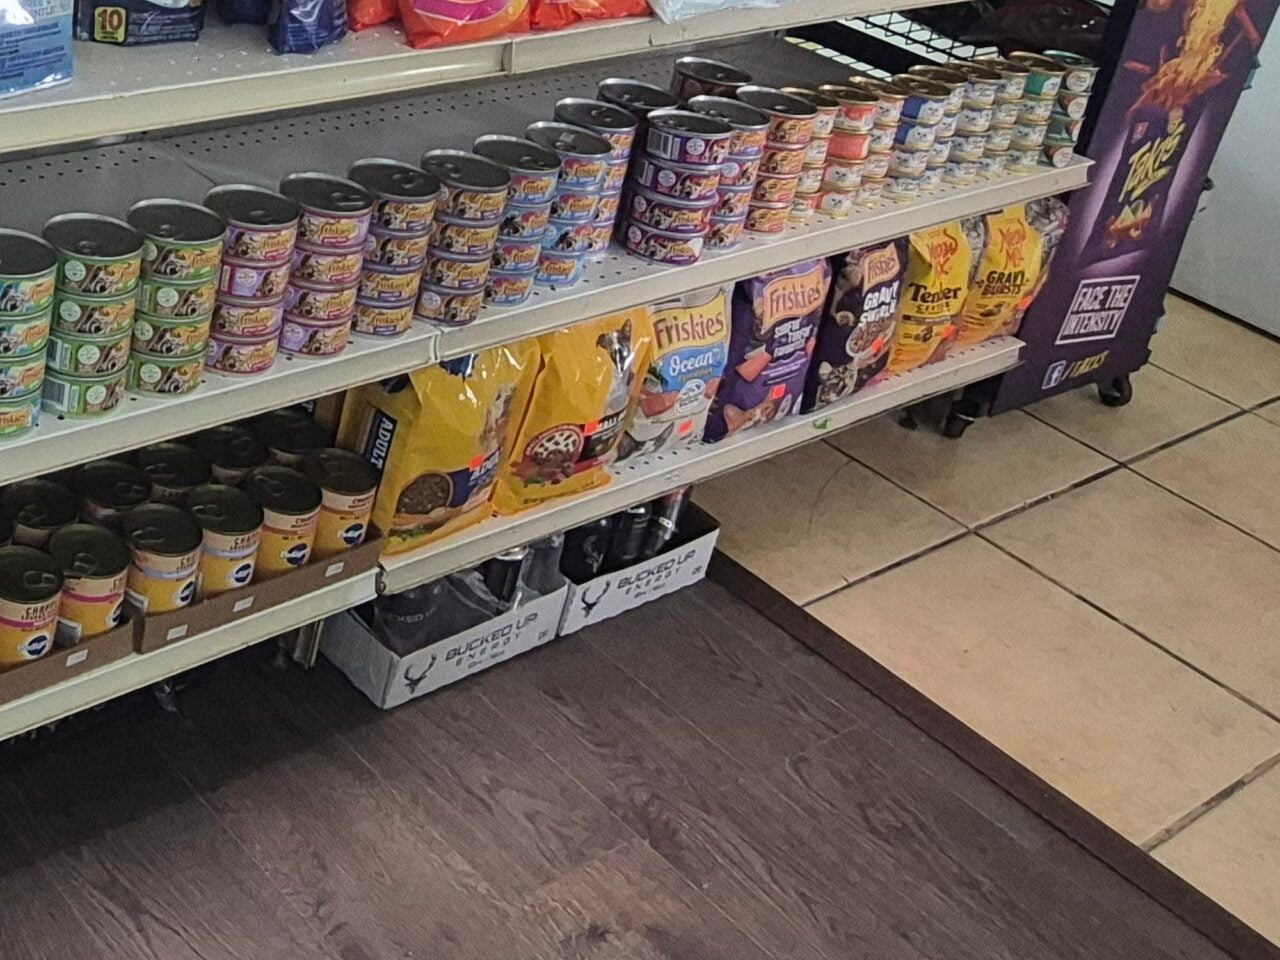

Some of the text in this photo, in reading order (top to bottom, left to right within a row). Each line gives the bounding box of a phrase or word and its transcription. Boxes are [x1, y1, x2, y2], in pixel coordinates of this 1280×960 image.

[96, 8, 124, 28] 10
[770, 282, 820, 319] Friskies
[863, 281, 900, 311] GRAVY
[908, 282, 962, 304] Tender
[1072, 284, 1133, 312] FACE THE
[653, 312, 724, 349] Friskies
[1063, 310, 1124, 336] INTENSITY
[669, 351, 712, 376] Ocean
[370, 415, 397, 470] ADULT
[617, 549, 696, 589] BUCKED UP
[625, 567, 681, 595] ENERGY
[445, 611, 538, 663] BUCKED UP
[455, 632, 521, 667] ENERGY
